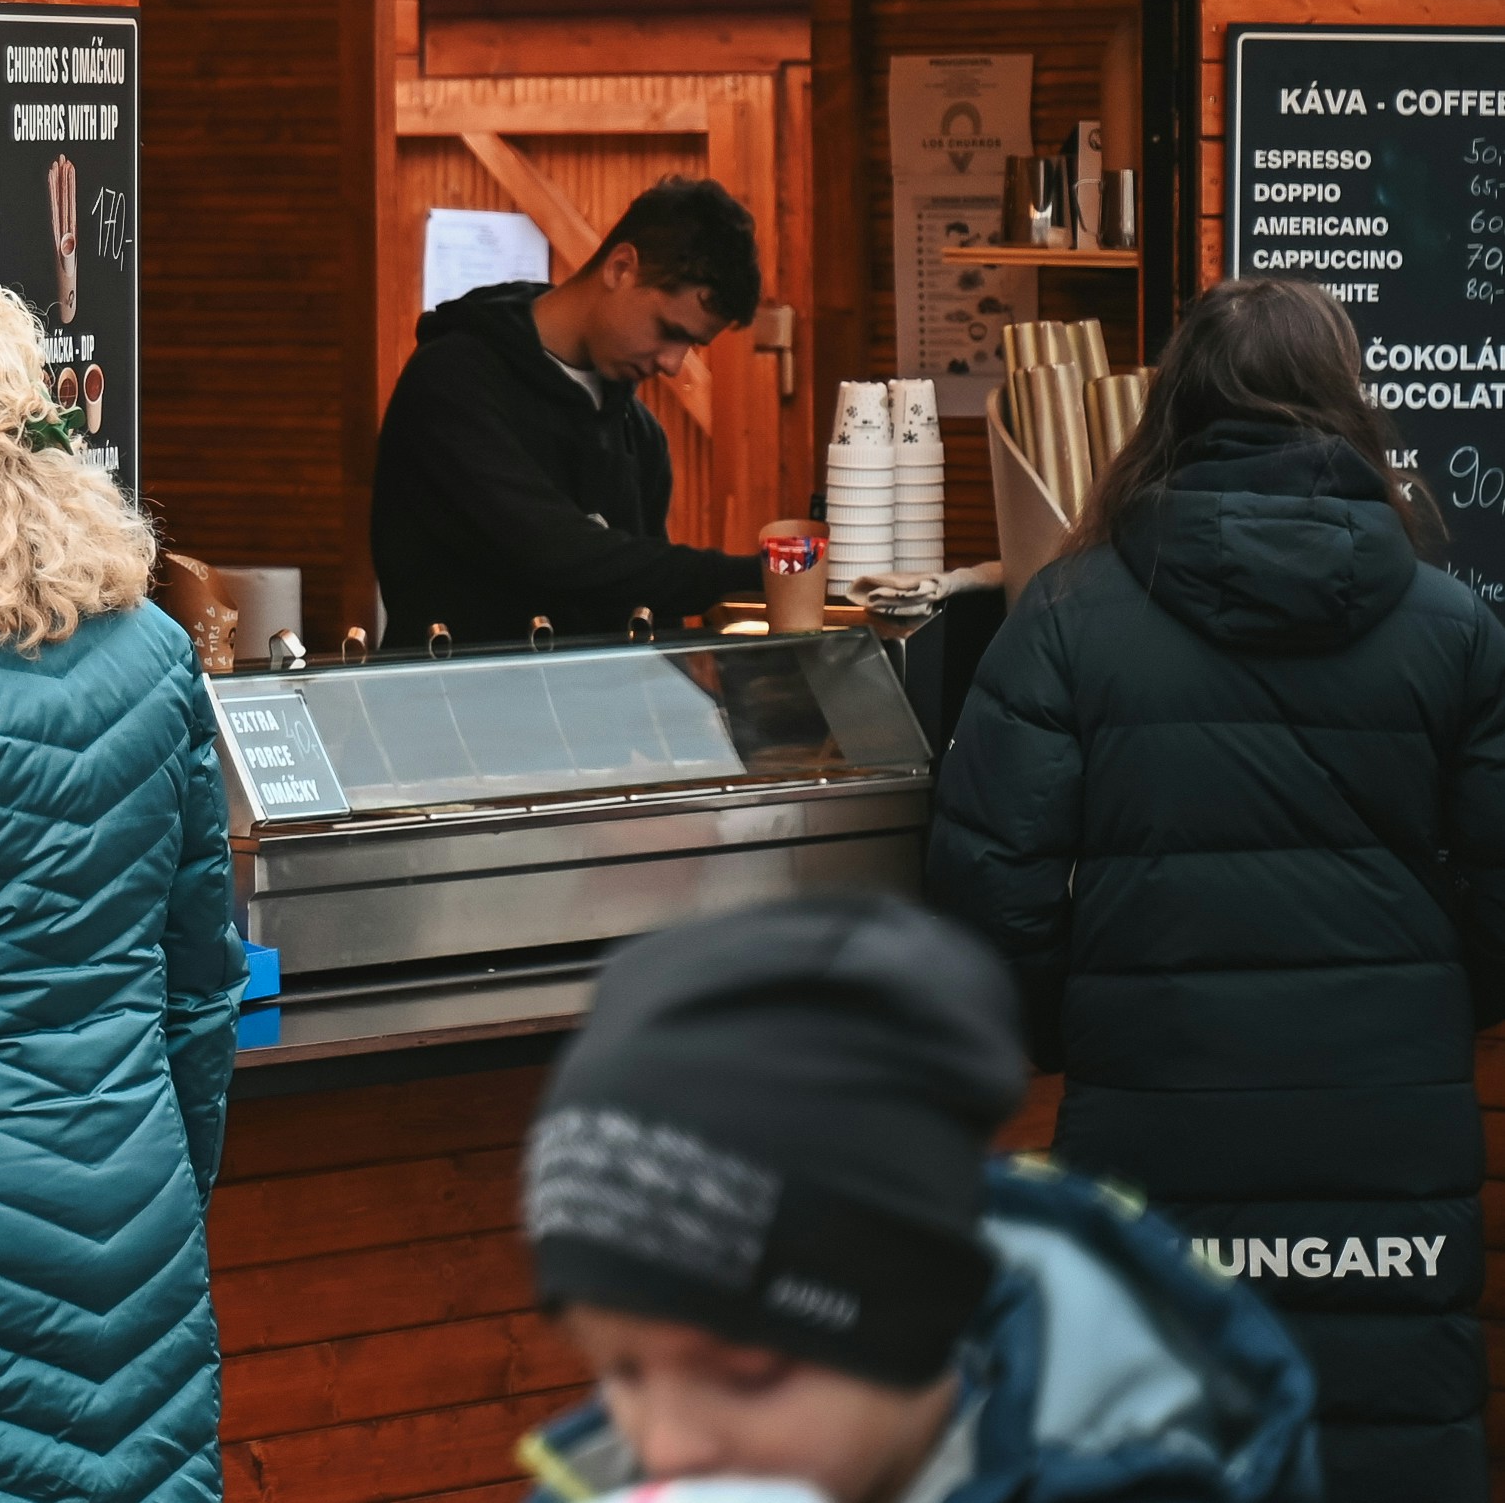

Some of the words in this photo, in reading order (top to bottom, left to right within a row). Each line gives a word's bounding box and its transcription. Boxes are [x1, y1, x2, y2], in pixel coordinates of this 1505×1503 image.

[6, 46, 59, 85] CHURROS
[61, 45, 69, 84] S
[72, 37, 125, 85] OMÁČKOU
[1280, 80, 1367, 116] KÁVA
[13, 104, 66, 142] CHURROS
[68, 104, 98, 141] WITH
[100, 104, 119, 141] DIP
[1253, 149, 1372, 171] ESPRESSO
[1253, 183, 1342, 203] DOPPIO
[1253, 216, 1389, 237] AMERICANO
[1253, 249, 1403, 270] CAPPUCCINO
[1319, 282, 1380, 303] HITE
[44, 328, 74, 364] MÁČKA
[81, 334, 95, 362] DIP
[1365, 336, 1505, 371] ČOKOLÁ
[1359, 382, 1505, 410] HOCOLAT
[208, 625, 221, 654] TIPS
[229, 709, 280, 734] EXTRA
[244, 744, 295, 769] PORCE
[259, 774, 321, 805] OMÁČKY
[1191, 1235, 1447, 1278] UNGARY
